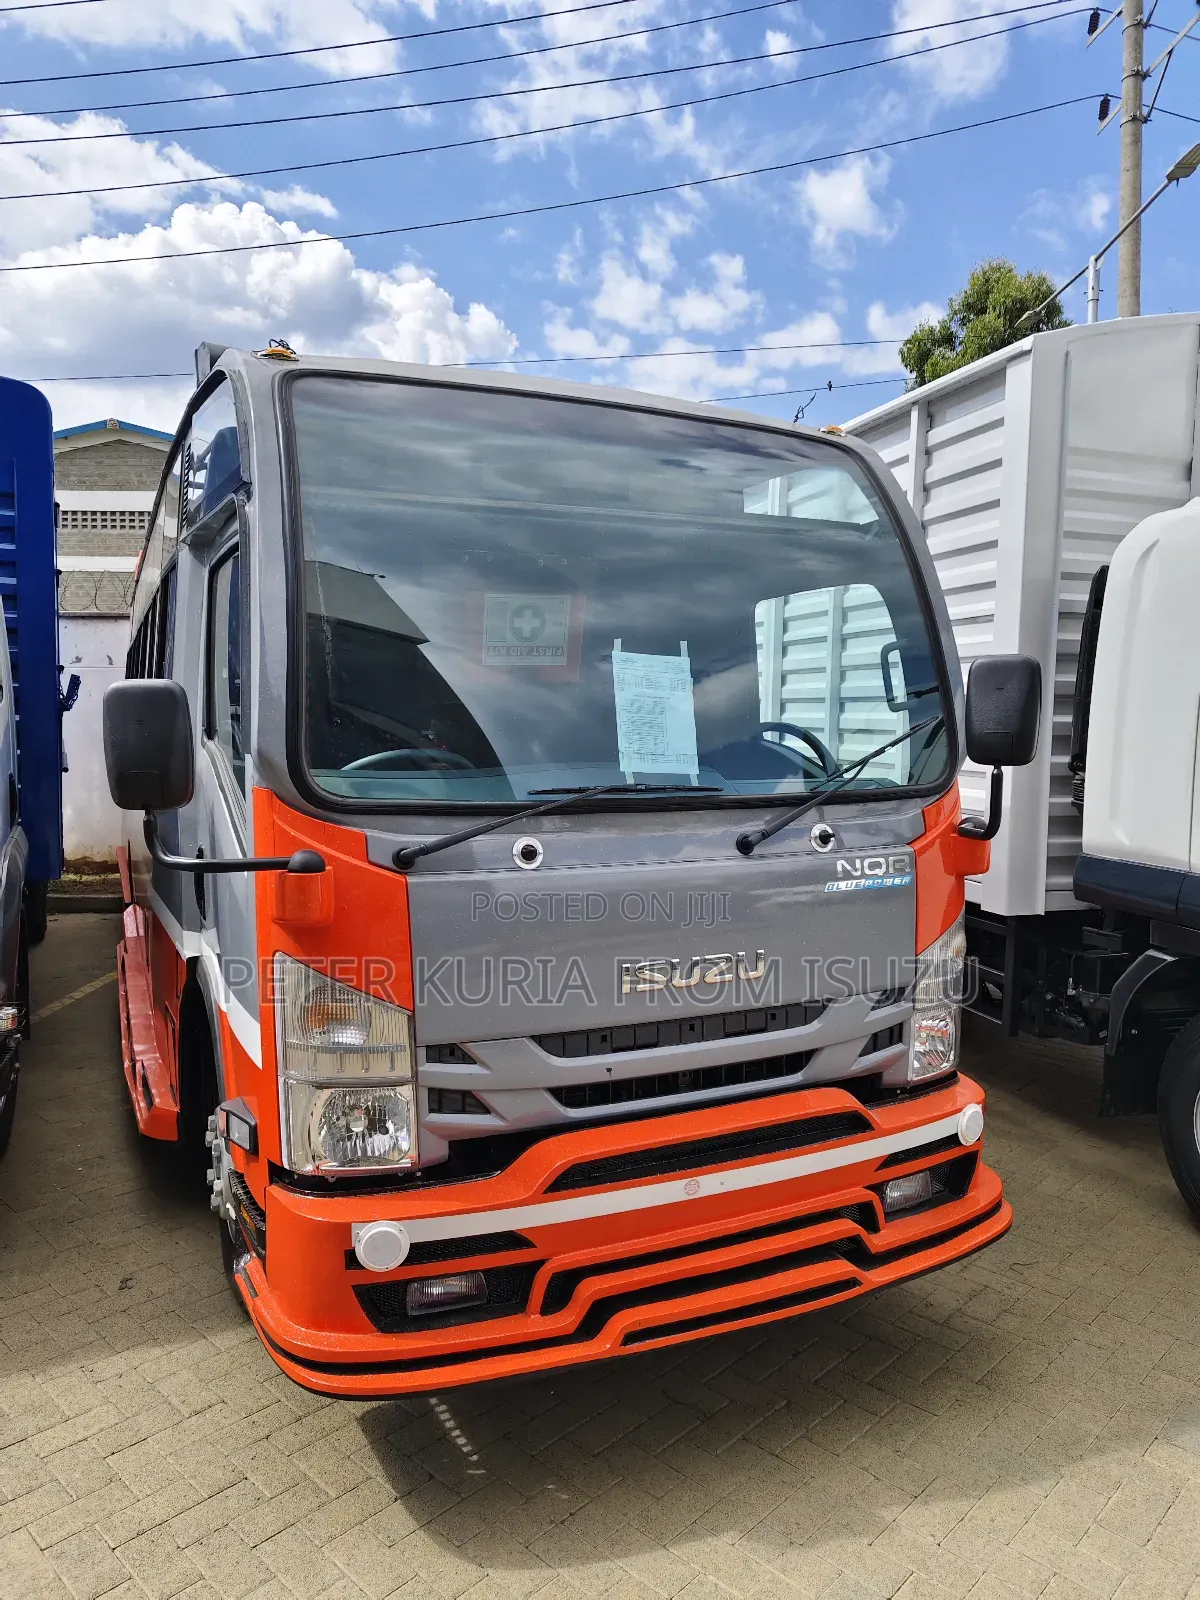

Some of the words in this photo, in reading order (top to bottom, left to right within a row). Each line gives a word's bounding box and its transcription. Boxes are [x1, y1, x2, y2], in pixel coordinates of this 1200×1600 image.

[532, 645, 564, 656] FIRST
[836, 855, 911, 878] NQR
[620, 949, 767, 994] ISUZU
